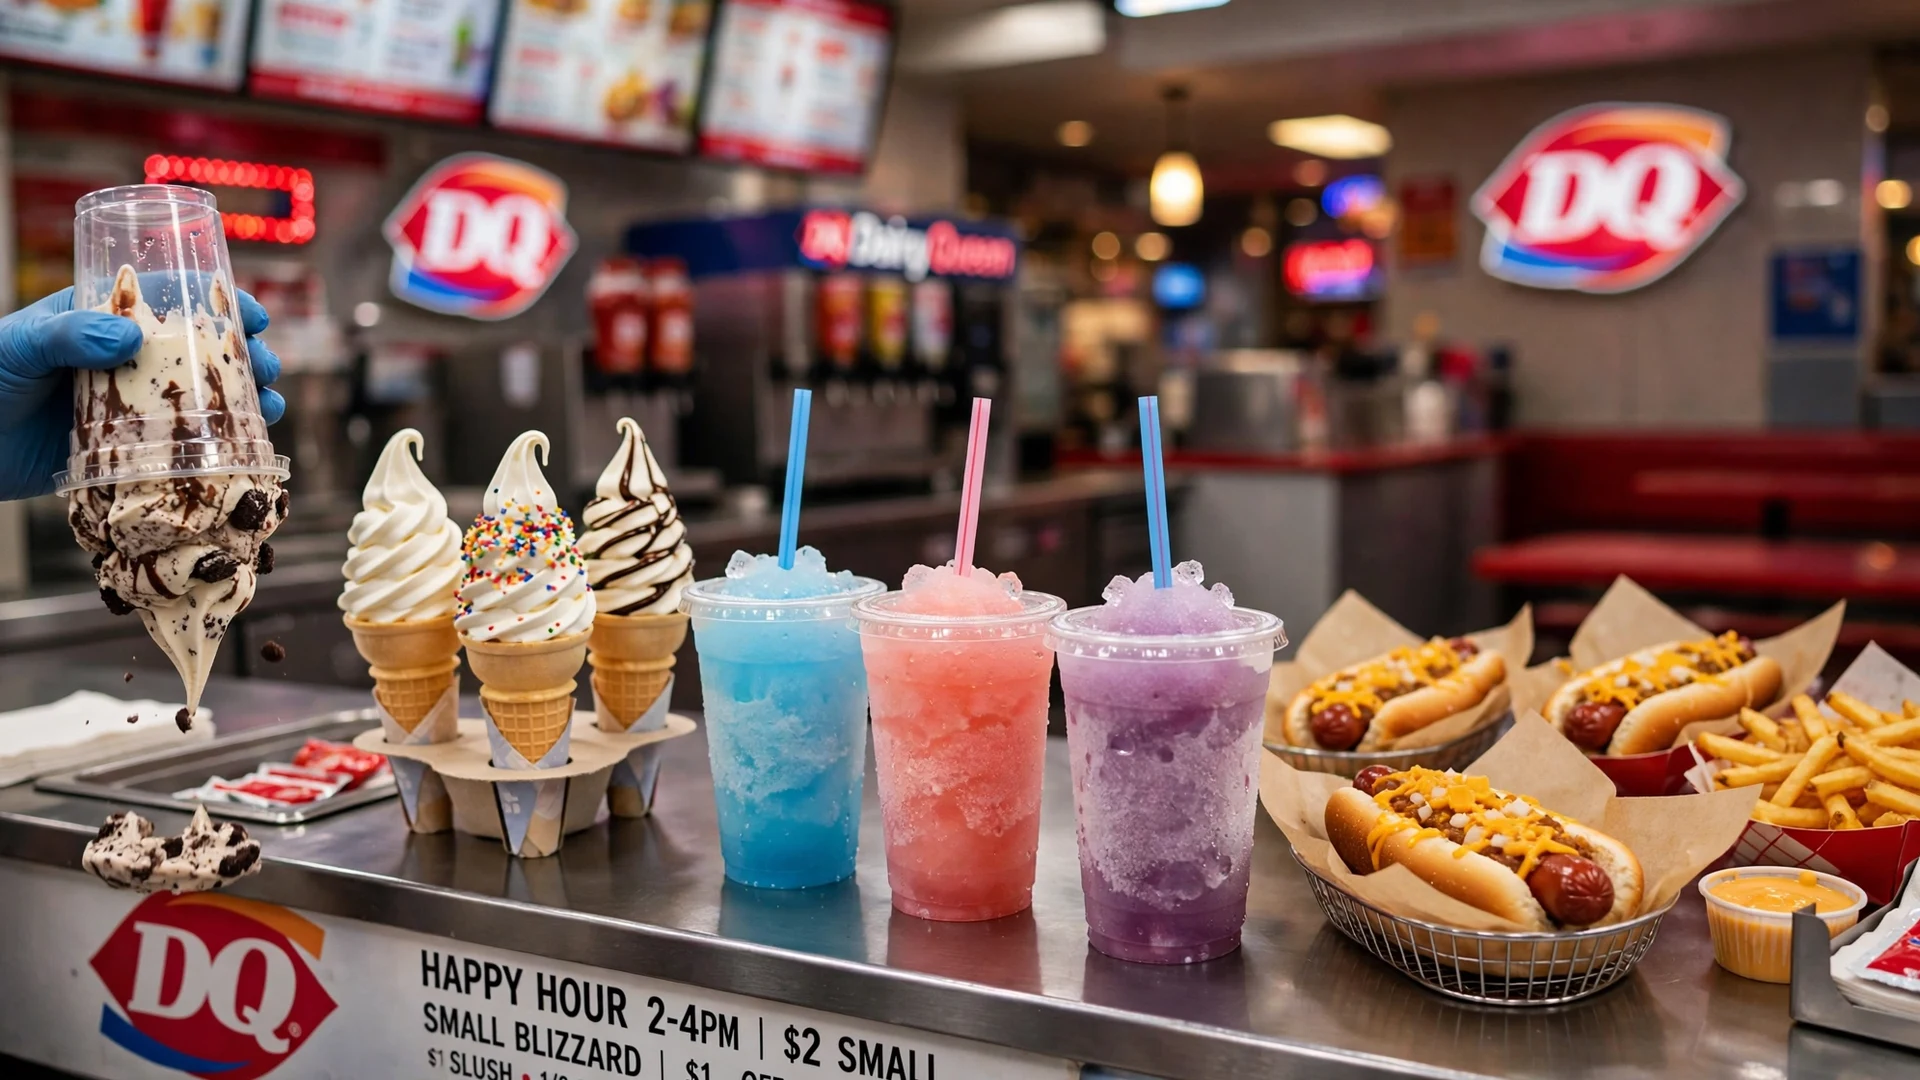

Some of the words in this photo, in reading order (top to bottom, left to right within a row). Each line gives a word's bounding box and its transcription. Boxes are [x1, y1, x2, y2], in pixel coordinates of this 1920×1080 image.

[419, 187, 549, 289] DQ
[1518, 144, 1700, 252] DQ
[127, 921, 297, 1055] DQ
[421, 949, 524, 1006] HAPPY
[536, 971, 628, 1029] HOUR
[647, 996, 740, 1051] 2-4PM
[784, 1024, 821, 1067] $2
[423, 1002, 505, 1048] SMALL
[515, 1021, 642, 1077] BLIZZARD
[450, 1050, 512, 1080] SLUSH
